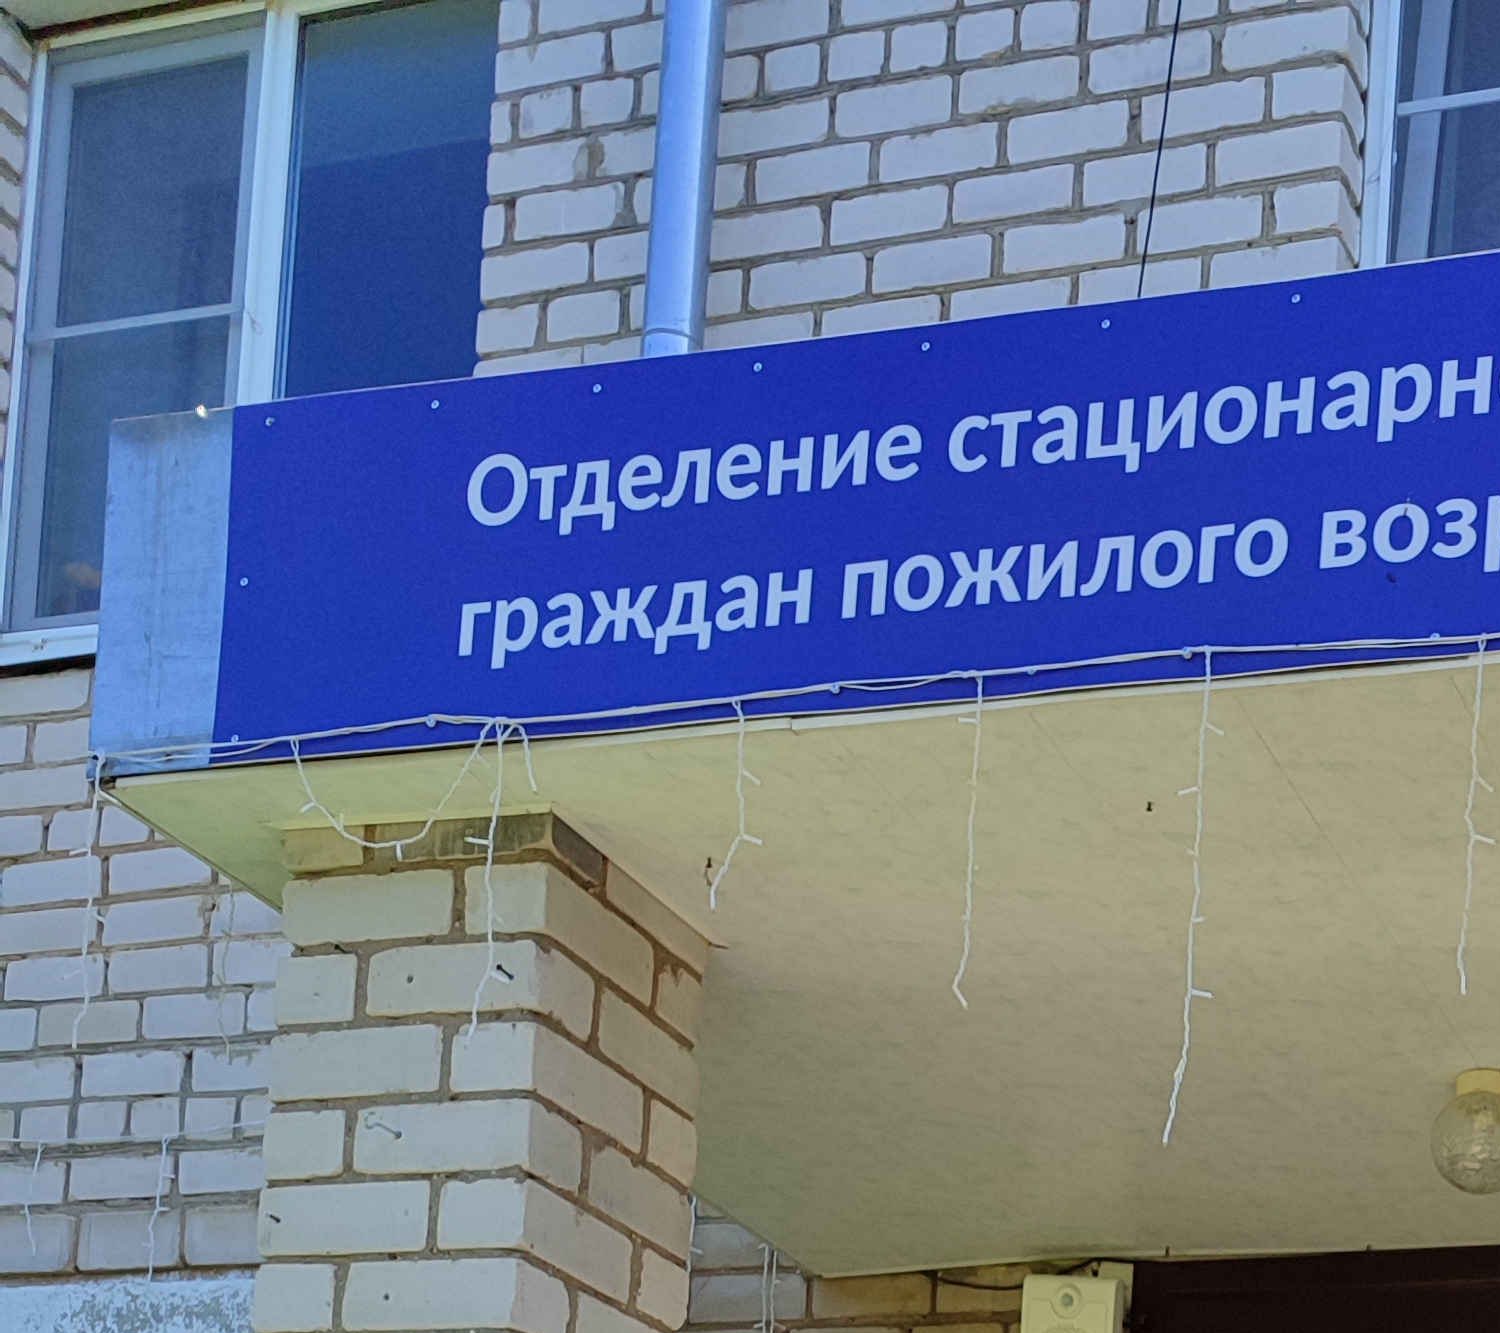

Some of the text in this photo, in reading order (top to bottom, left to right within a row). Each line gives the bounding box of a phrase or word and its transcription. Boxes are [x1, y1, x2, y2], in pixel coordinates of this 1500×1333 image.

[466, 424, 922, 536] Отделение
[458, 568, 813, 670] граждан
[841, 518, 1289, 619] пожилого
